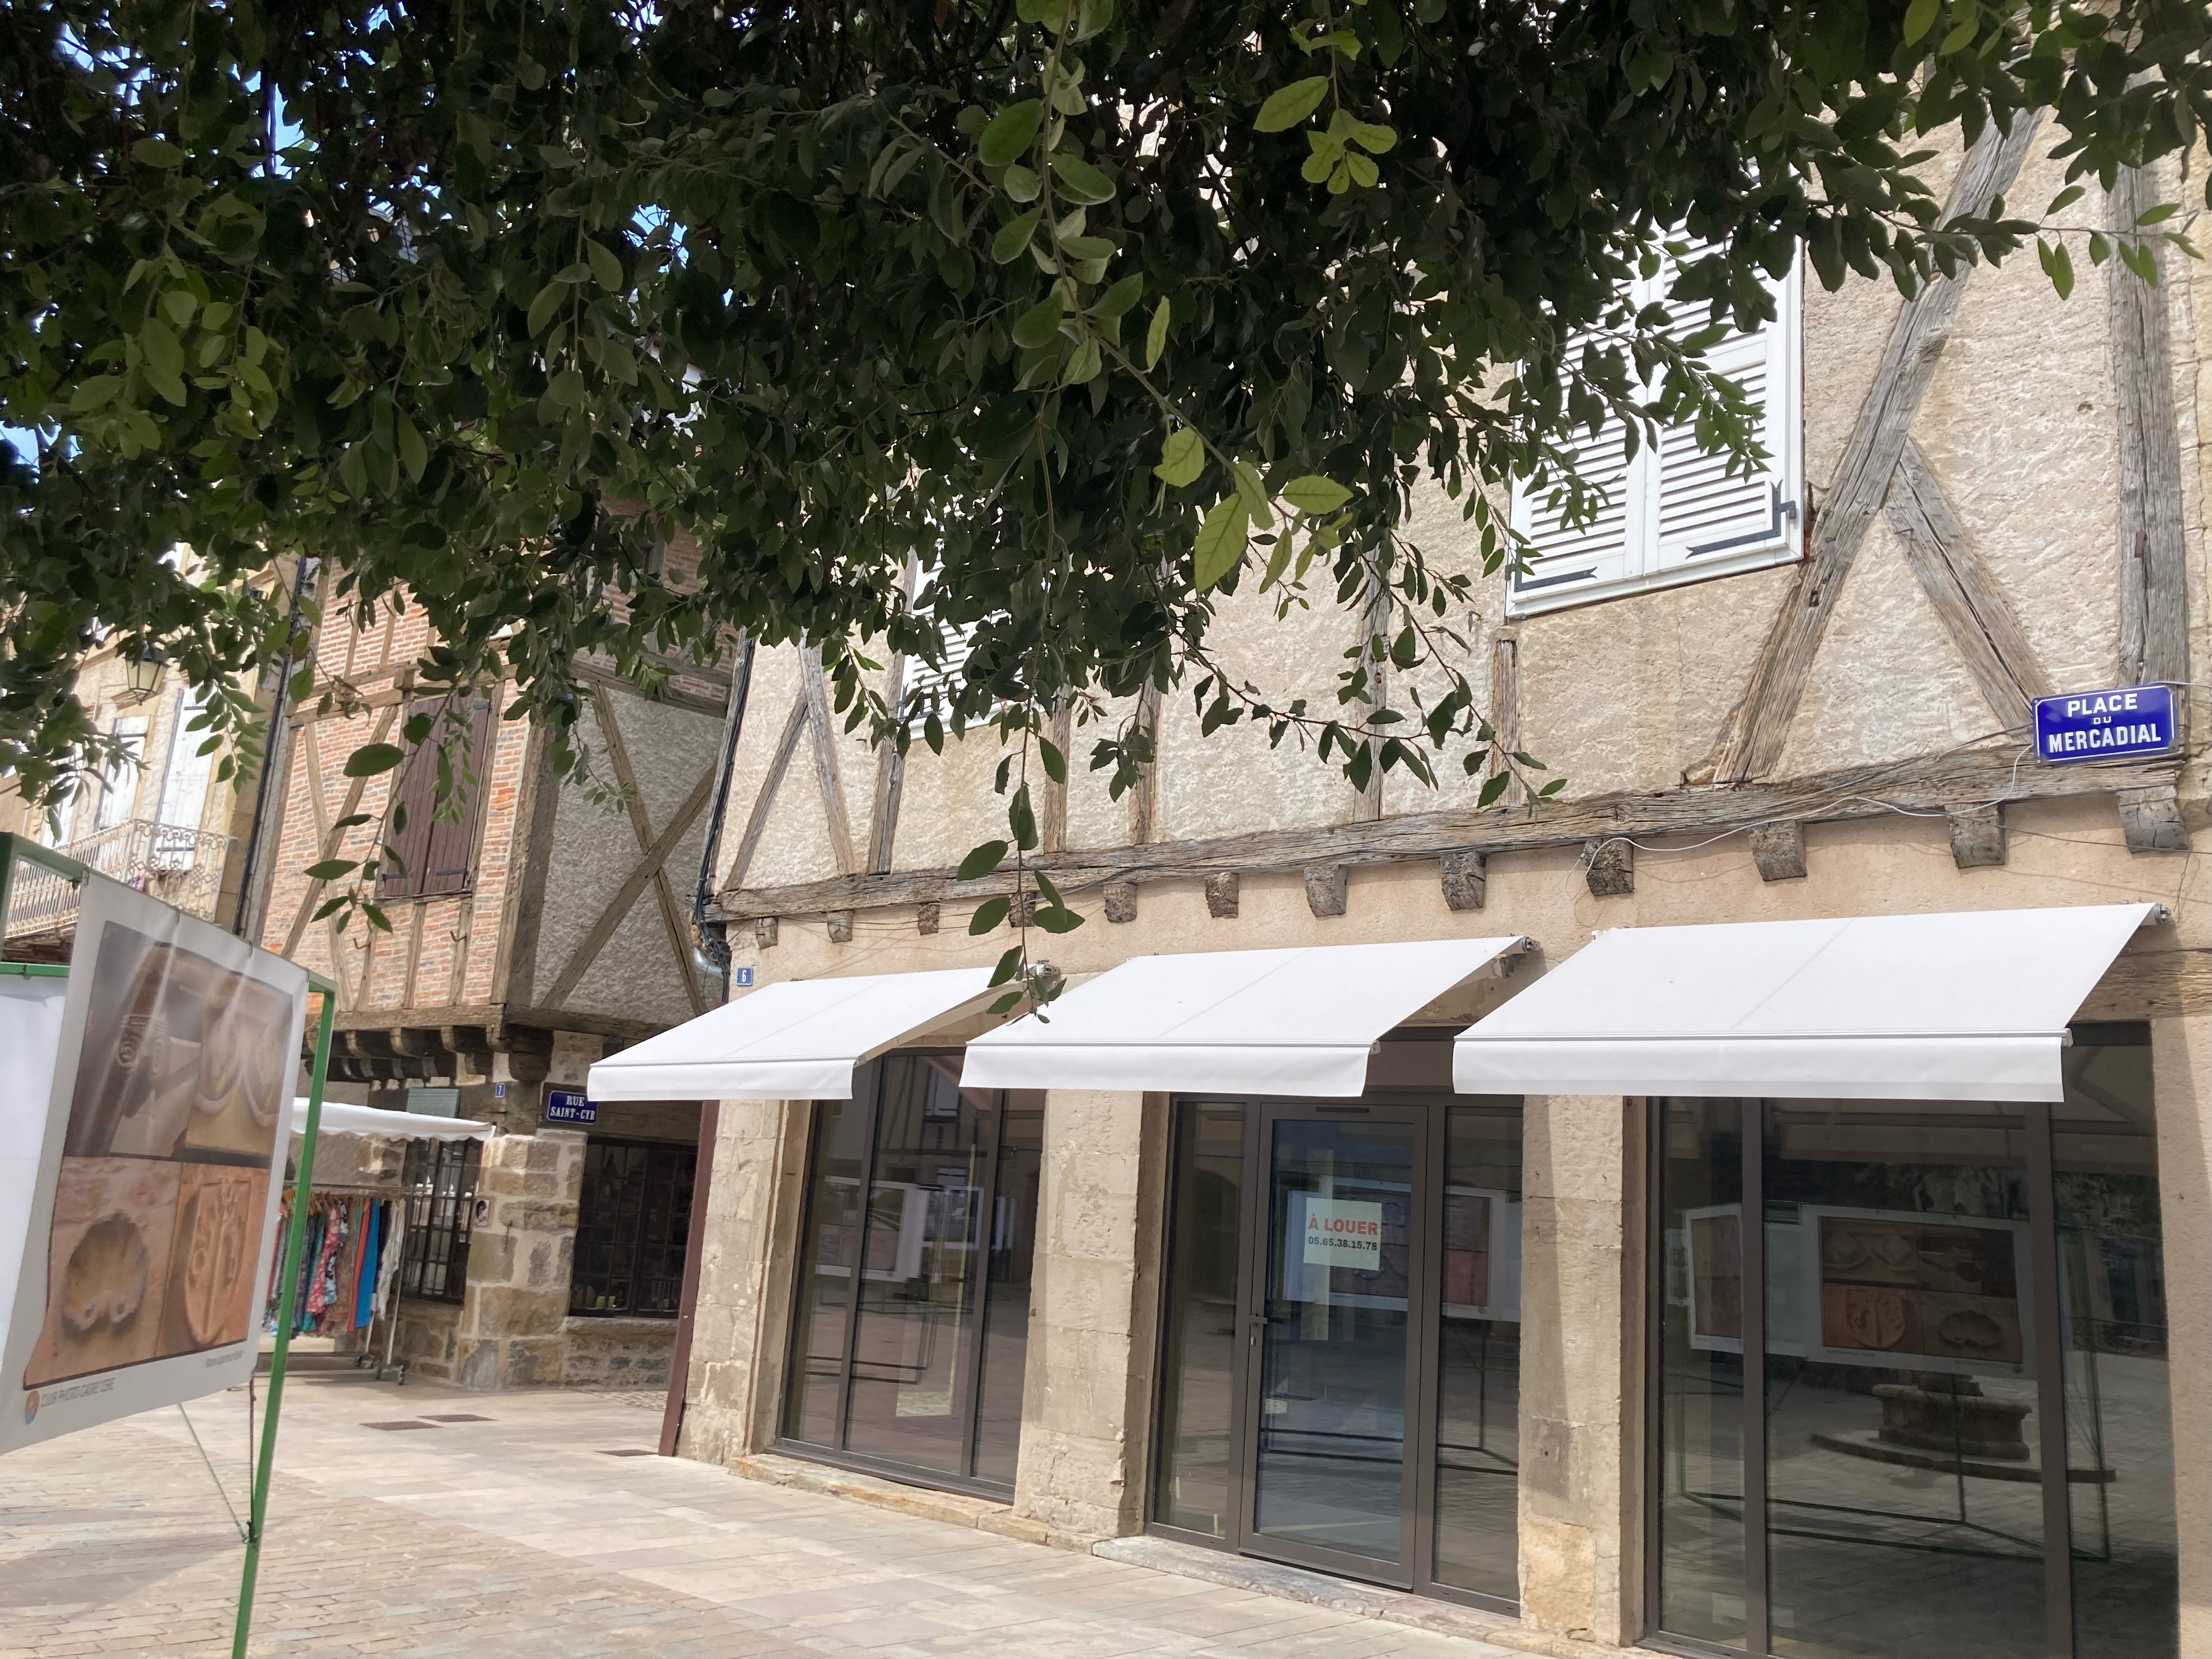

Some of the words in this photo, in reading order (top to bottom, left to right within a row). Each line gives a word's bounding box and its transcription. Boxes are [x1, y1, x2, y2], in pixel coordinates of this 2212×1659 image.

[2067, 692, 2138, 718] PLACE
[2093, 715, 2112, 725] DU
[2049, 723, 2162, 753] MERCADIAL
[742, 969, 747, 983] 6
[566, 1095, 585, 1107] RUE
[550, 1106, 596, 1120] SAINT-CYR
[1308, 1214, 1319, 1230] À
[1324, 1218, 1379, 1235] LOUER
[1308, 1236, 1378, 1251] 05.65.38.15.78
